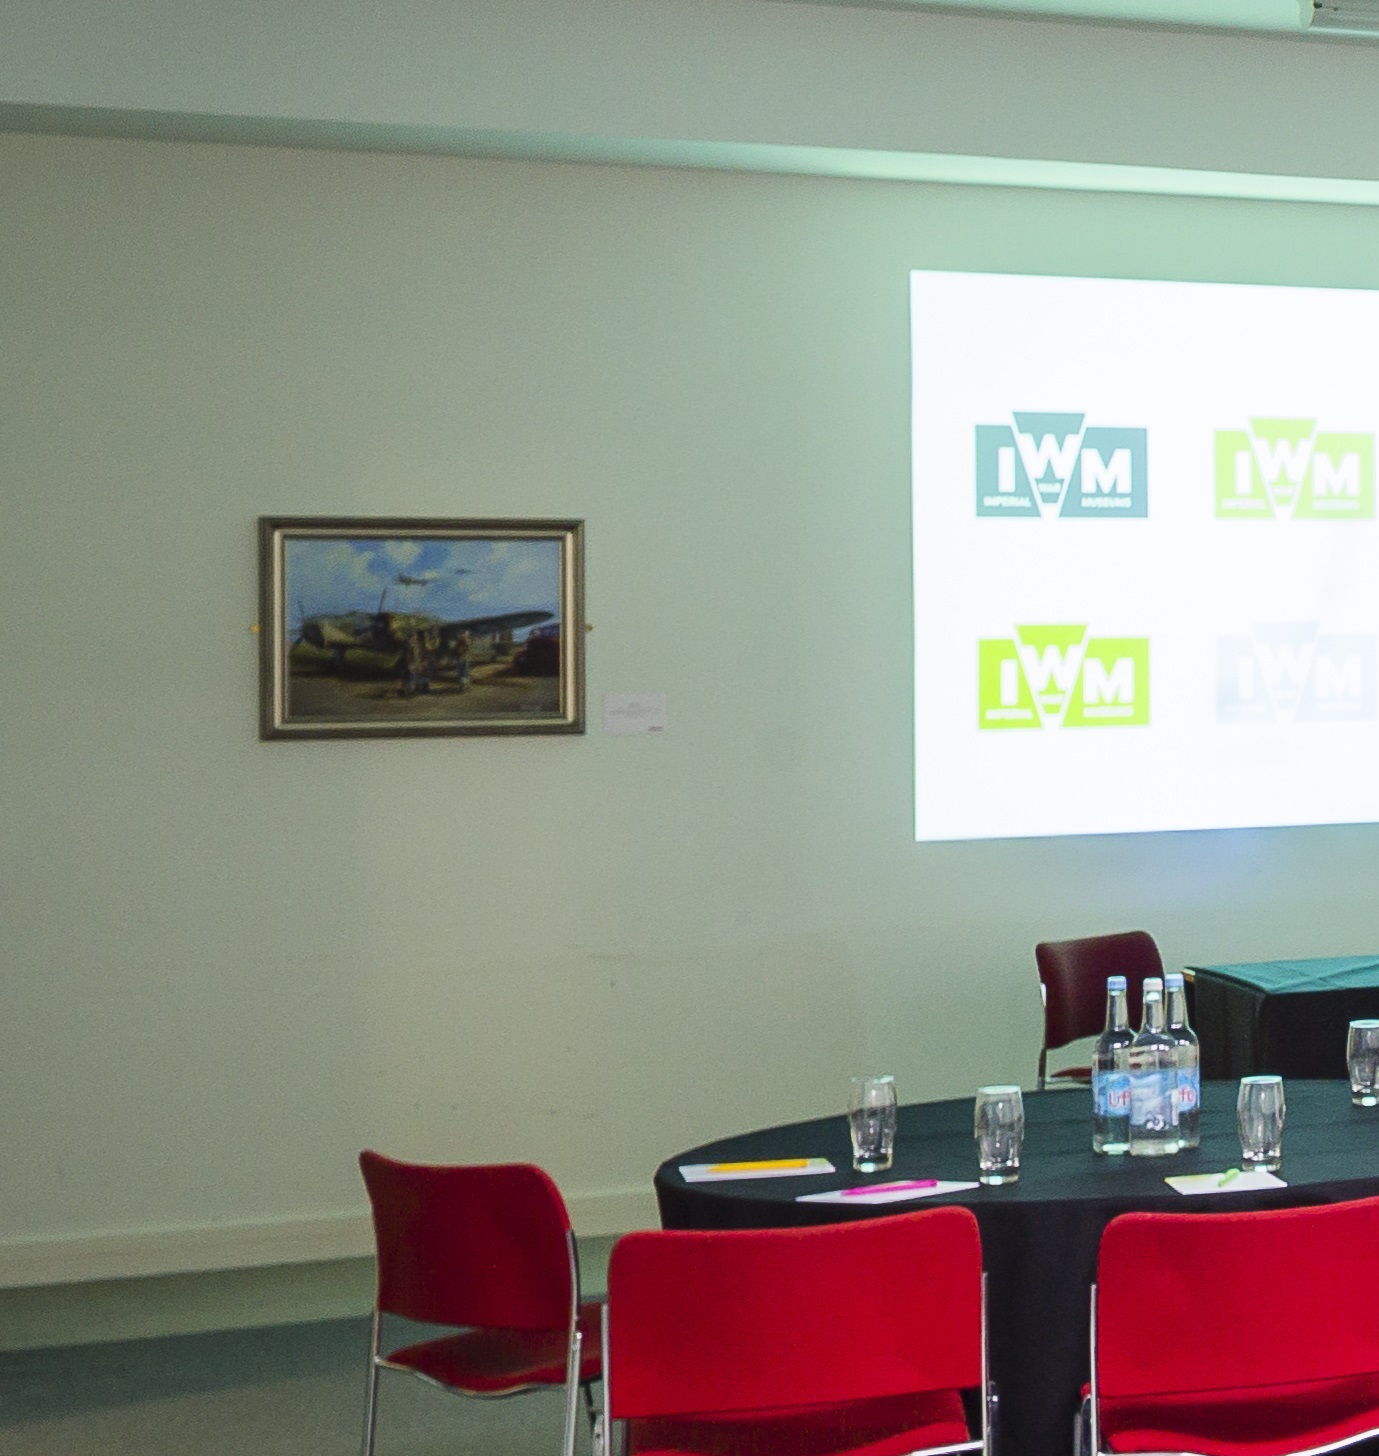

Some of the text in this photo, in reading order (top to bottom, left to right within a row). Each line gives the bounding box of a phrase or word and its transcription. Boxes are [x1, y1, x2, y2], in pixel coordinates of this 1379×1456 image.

[998, 433, 1132, 494] IWM
[1235, 438, 1361, 497] IWM
[1001, 644, 1135, 706] IWM
[1238, 643, 1362, 699] IWM
